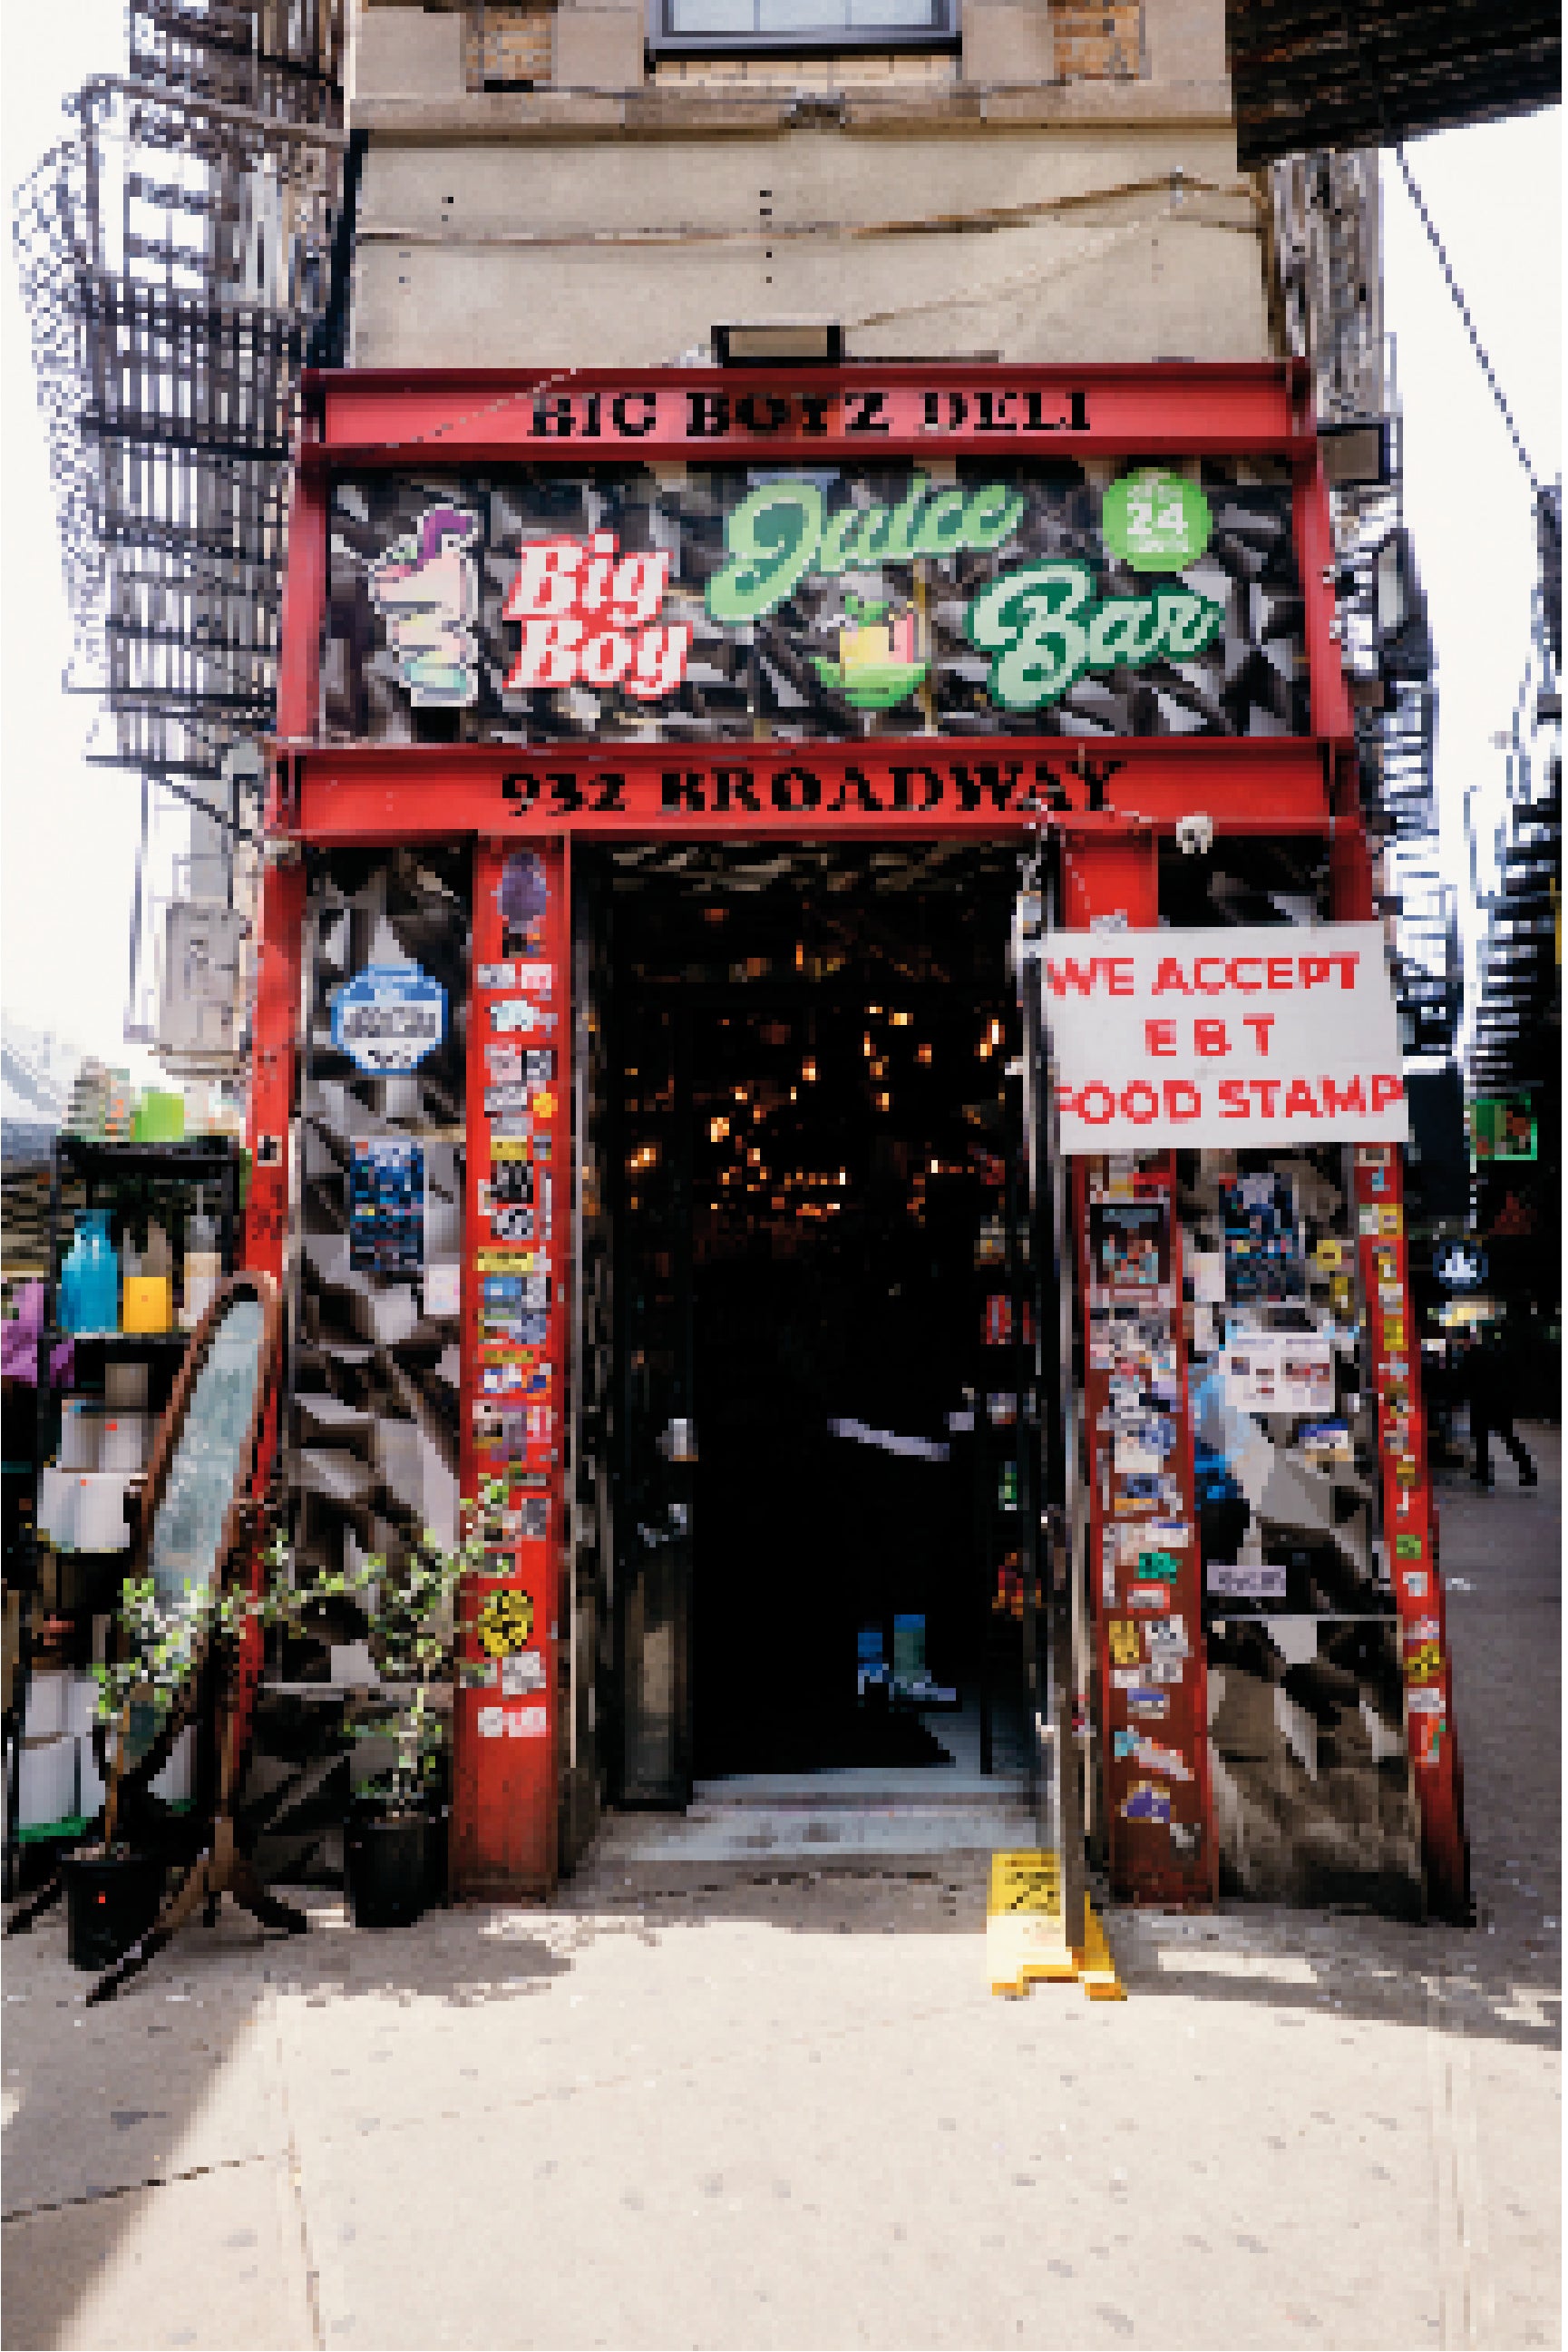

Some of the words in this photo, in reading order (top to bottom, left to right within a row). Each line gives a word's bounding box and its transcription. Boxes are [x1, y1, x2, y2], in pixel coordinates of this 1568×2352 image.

[527, 392, 657, 437] BIG
[686, 392, 894, 437] BOYZ
[919, 392, 1091, 437] DELI
[706, 471, 1028, 621] Juice
[1126, 503, 1188, 535] 24
[502, 529, 674, 628] Big
[502, 620, 693, 700] Boy
[964, 559, 1224, 712] Bar
[502, 772, 627, 816] 932
[657, 760, 1127, 812] BROADWAY
[1047, 957, 1135, 998] WE
[1152, 952, 1360, 996] ACCEPT
[1218, 1075, 1404, 1118] STAMP
